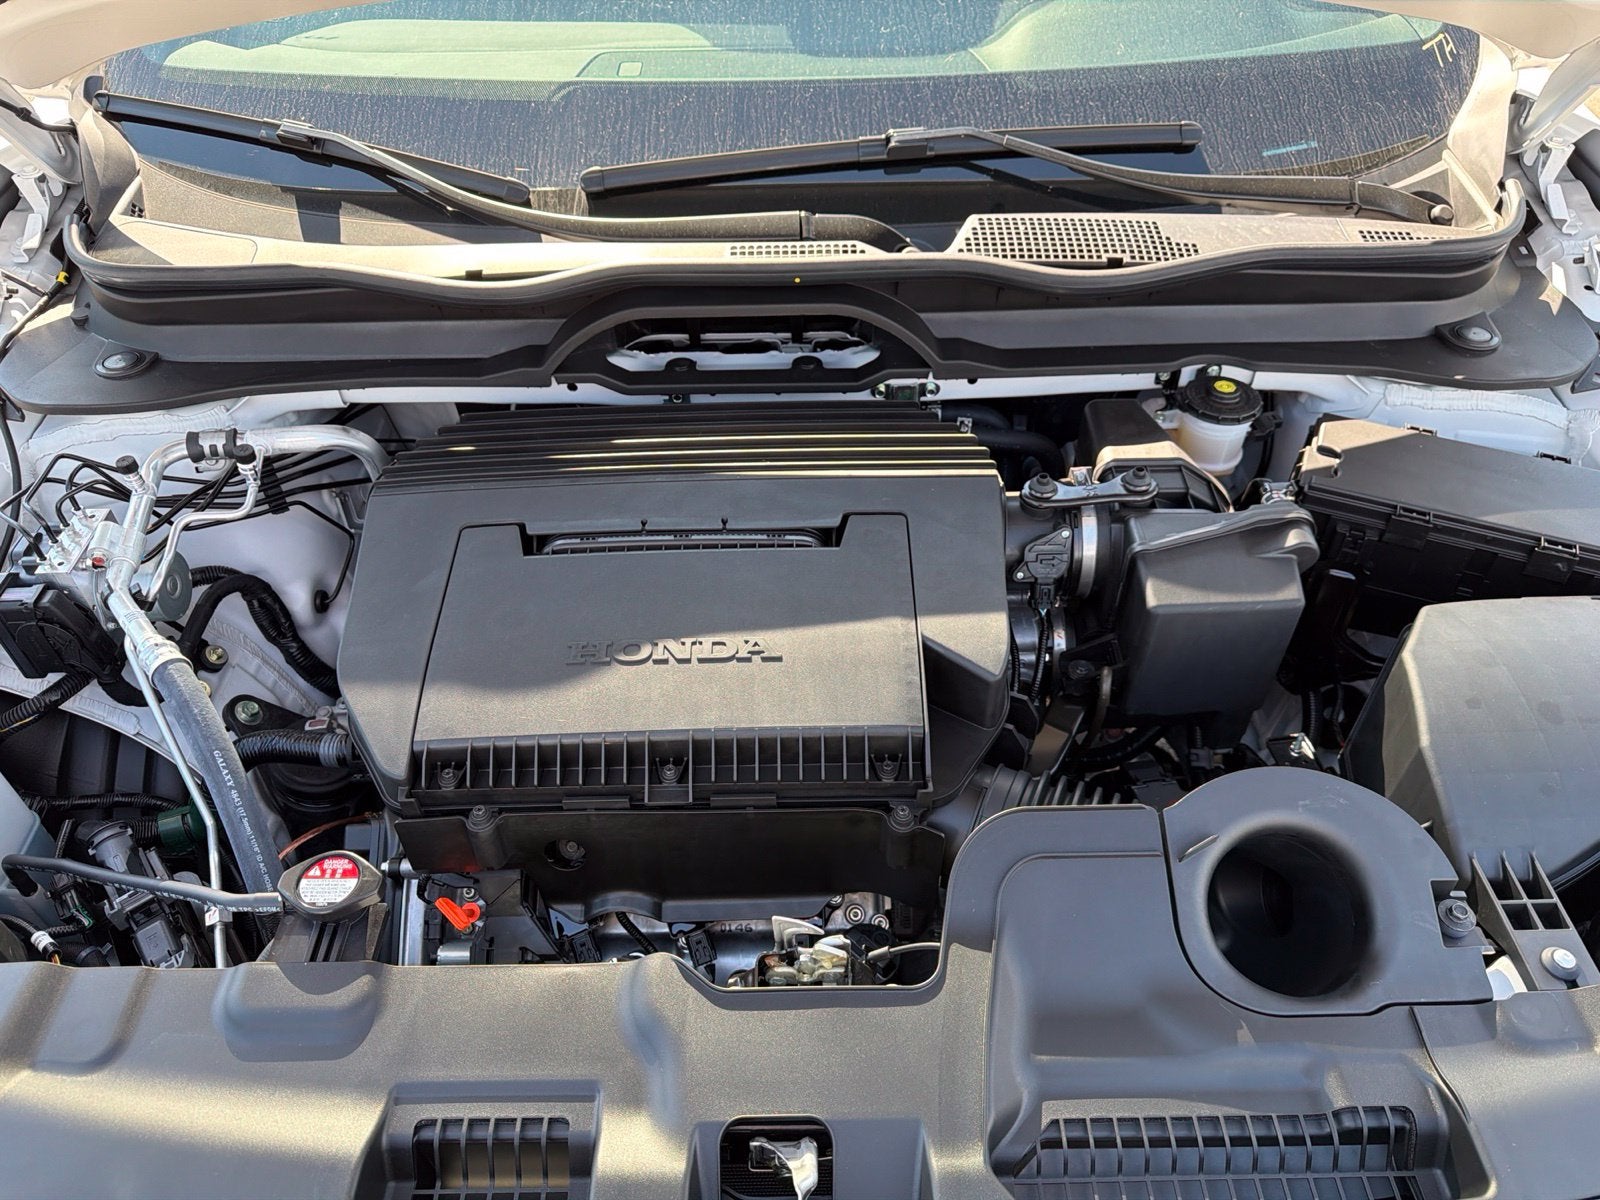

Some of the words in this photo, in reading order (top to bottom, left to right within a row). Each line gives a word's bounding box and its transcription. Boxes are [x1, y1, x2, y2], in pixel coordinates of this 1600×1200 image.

[565, 637, 783, 666] HONDA
[213, 750, 235, 787] GALAXY
[230, 788, 243, 806] 4843
[262, 873, 274, 892] HOSE
